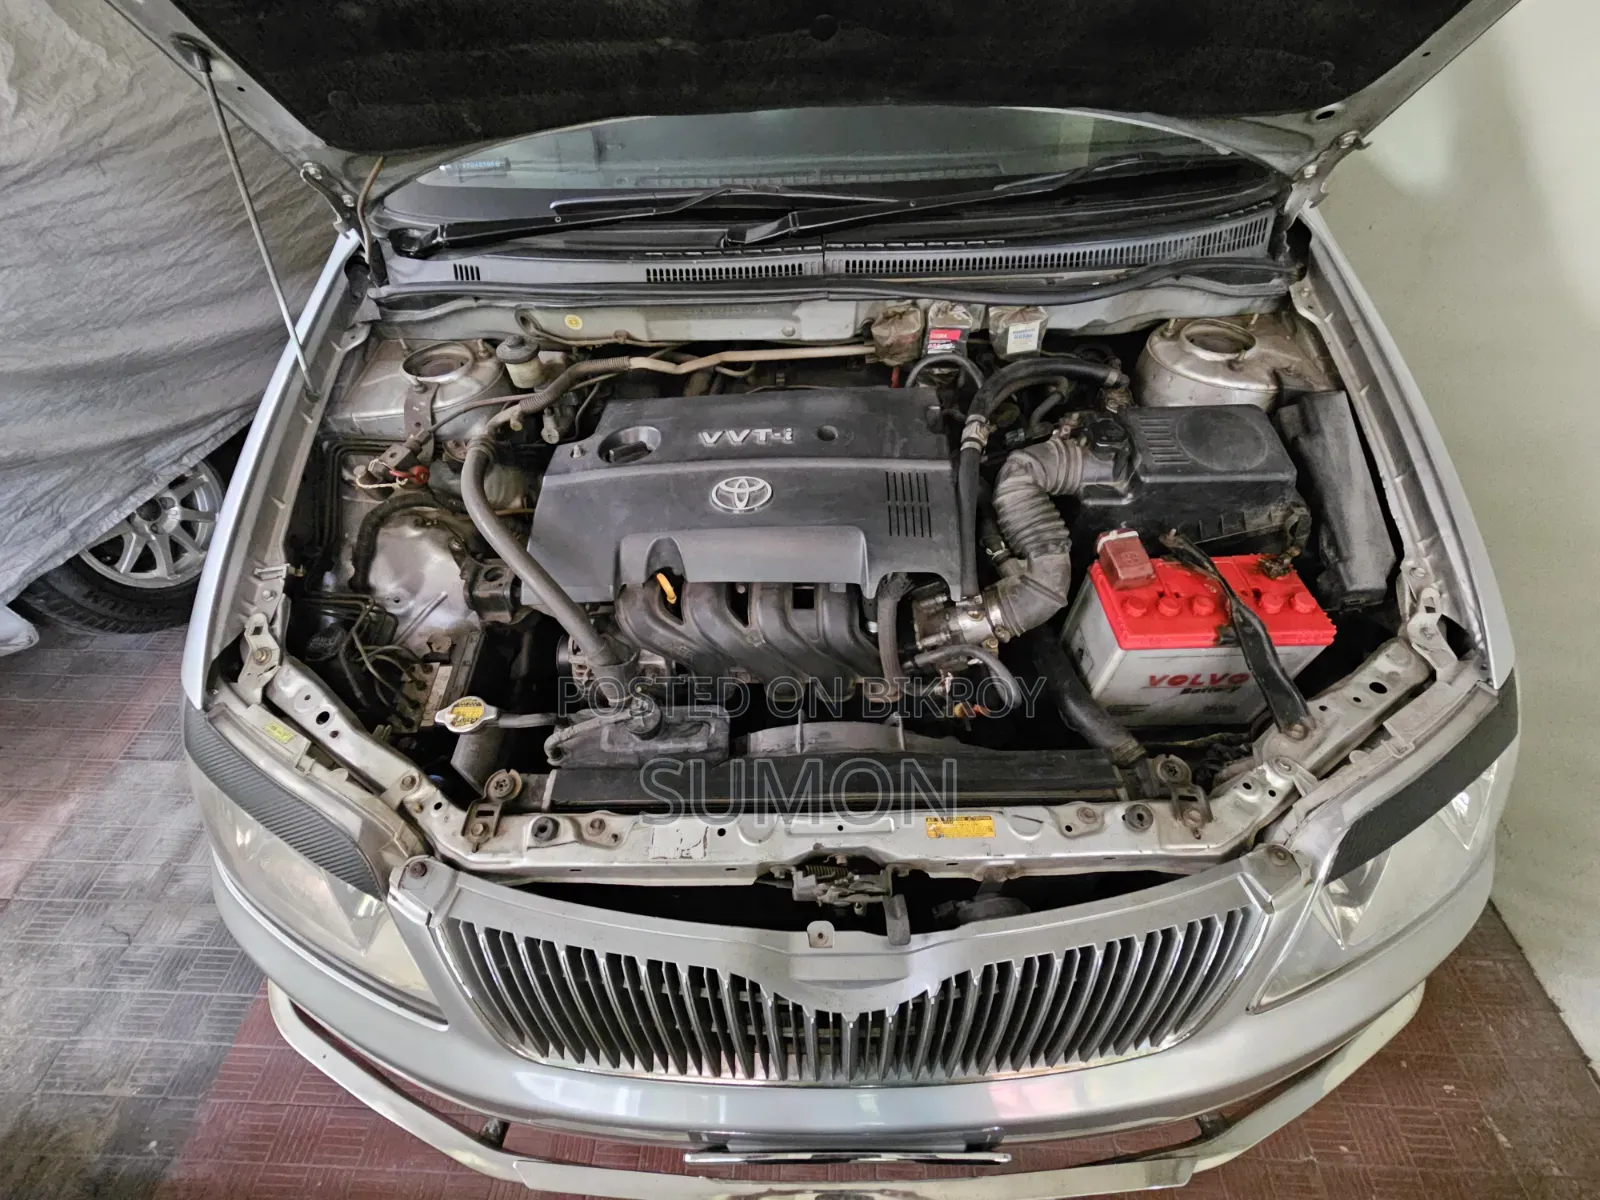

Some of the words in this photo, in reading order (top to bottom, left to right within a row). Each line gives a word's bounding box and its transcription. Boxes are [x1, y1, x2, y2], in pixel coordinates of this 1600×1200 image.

[699, 428, 794, 447] VVT-i
[1149, 672, 1250, 687] VOLVO
[1180, 685, 1242, 695] Battery
